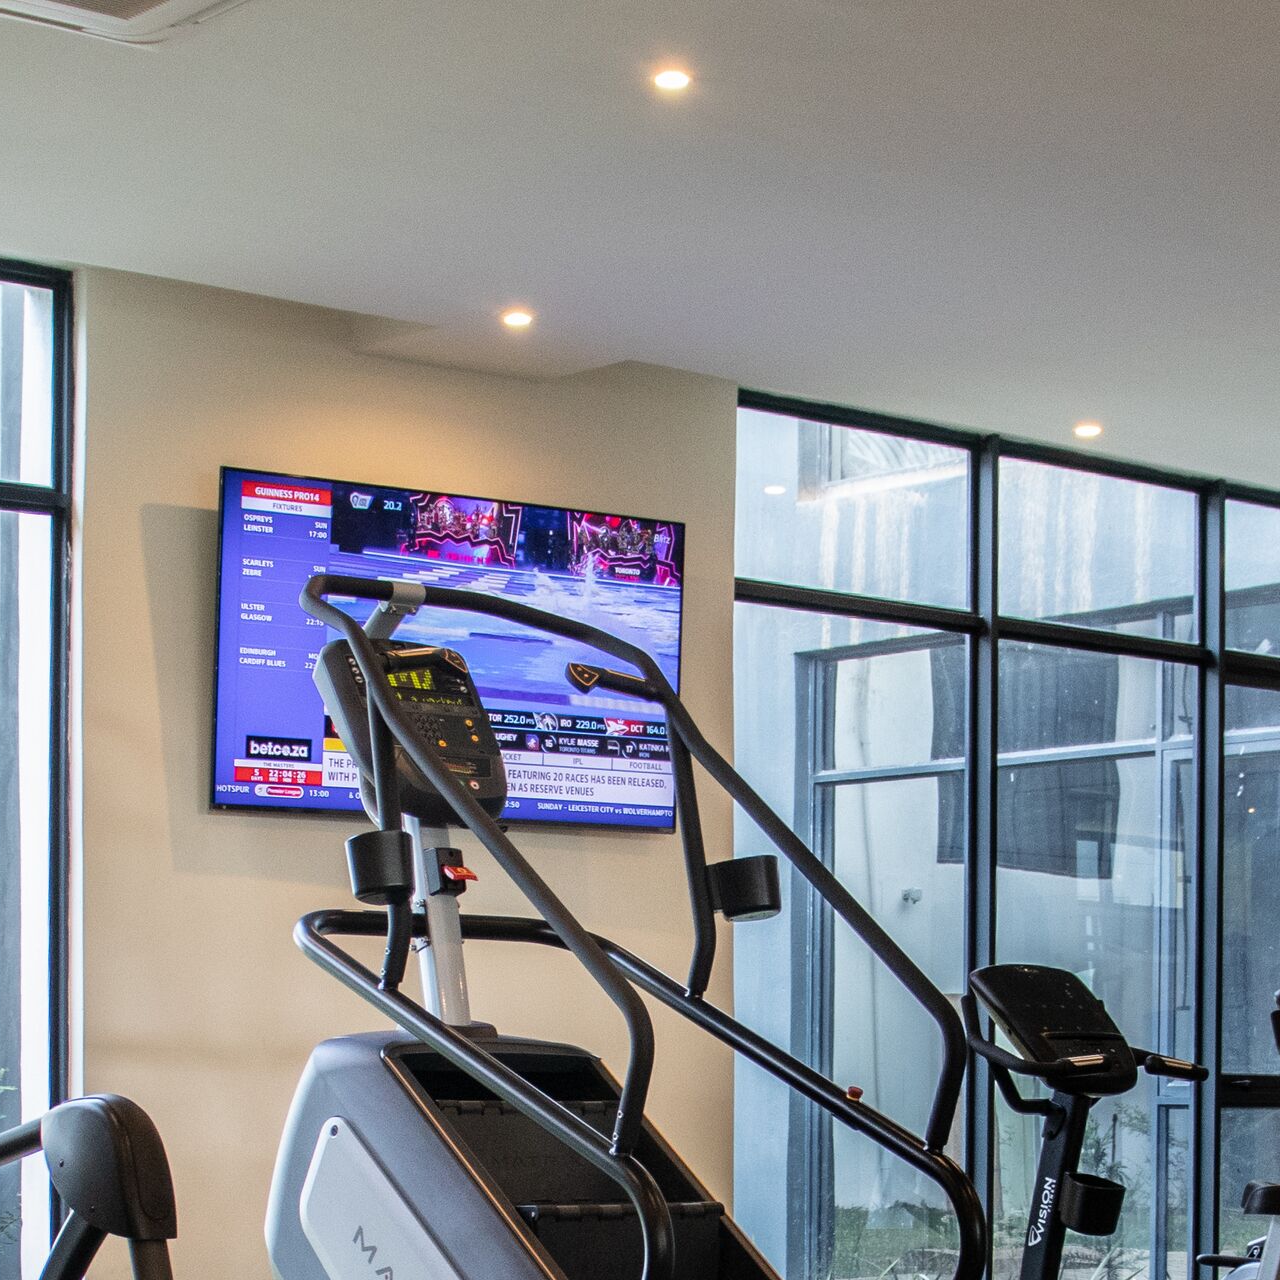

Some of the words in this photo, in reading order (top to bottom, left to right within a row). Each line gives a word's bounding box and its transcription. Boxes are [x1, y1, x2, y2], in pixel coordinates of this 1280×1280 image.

[255, 486, 293, 500] GUINNESS
[294, 491, 320, 502] PRO14
[272, 503, 303, 512] FIXTURES
[383, 500, 402, 511] 20.2
[243, 513, 273, 523] OSPREYS
[243, 524, 274, 534] LEINSTER
[315, 521, 328, 530] SUN
[308, 530, 328, 539] 17:00
[242, 558, 274, 568] SCARLETS
[242, 568, 262, 577] ZEBRE
[313, 565, 326, 573] SUN
[240, 602, 265, 612] ULSTER
[240, 612, 273, 622] GLASGOW
[239, 647, 277, 657] EDINBURGH
[308, 652, 320, 660] MO
[239, 657, 266, 666] CARDIFF
[266, 659, 287, 668] BLUES
[488, 713, 503, 722] TOR
[503, 714, 526, 725] 252.0
[560, 719, 572, 728] IRO
[575, 721, 597, 731] 229.0
[494, 733, 518, 742] UGHEY
[558, 737, 576, 746] KYLIE
[577, 739, 600, 748] MASSE
[503, 753, 522, 761] CKET
[329, 758, 344, 768] THE
[629, 761, 663, 771] FOOTBALL
[328, 771, 350, 782] WITH
[508, 769, 552, 781] FEATURING
[553, 772, 563, 782] 20
[564, 773, 589, 783] RACES
[590, 774, 606, 784] HAS
[607, 776, 626, 786] BEEN
[216, 784, 250, 794] HOTSPUR
[309, 789, 330, 798] 13:00
[506, 782, 516, 791] EN
[517, 782, 529, 792] AS
[530, 784, 564, 794] RESERVE
[565, 785, 595, 797] VENUES
[537, 802, 563, 811] SUNDAY
[568, 805, 600, 814] LEICESTER
[600, 806, 614, 814] CITY
[1036, 1176, 1056, 1233] VISION
